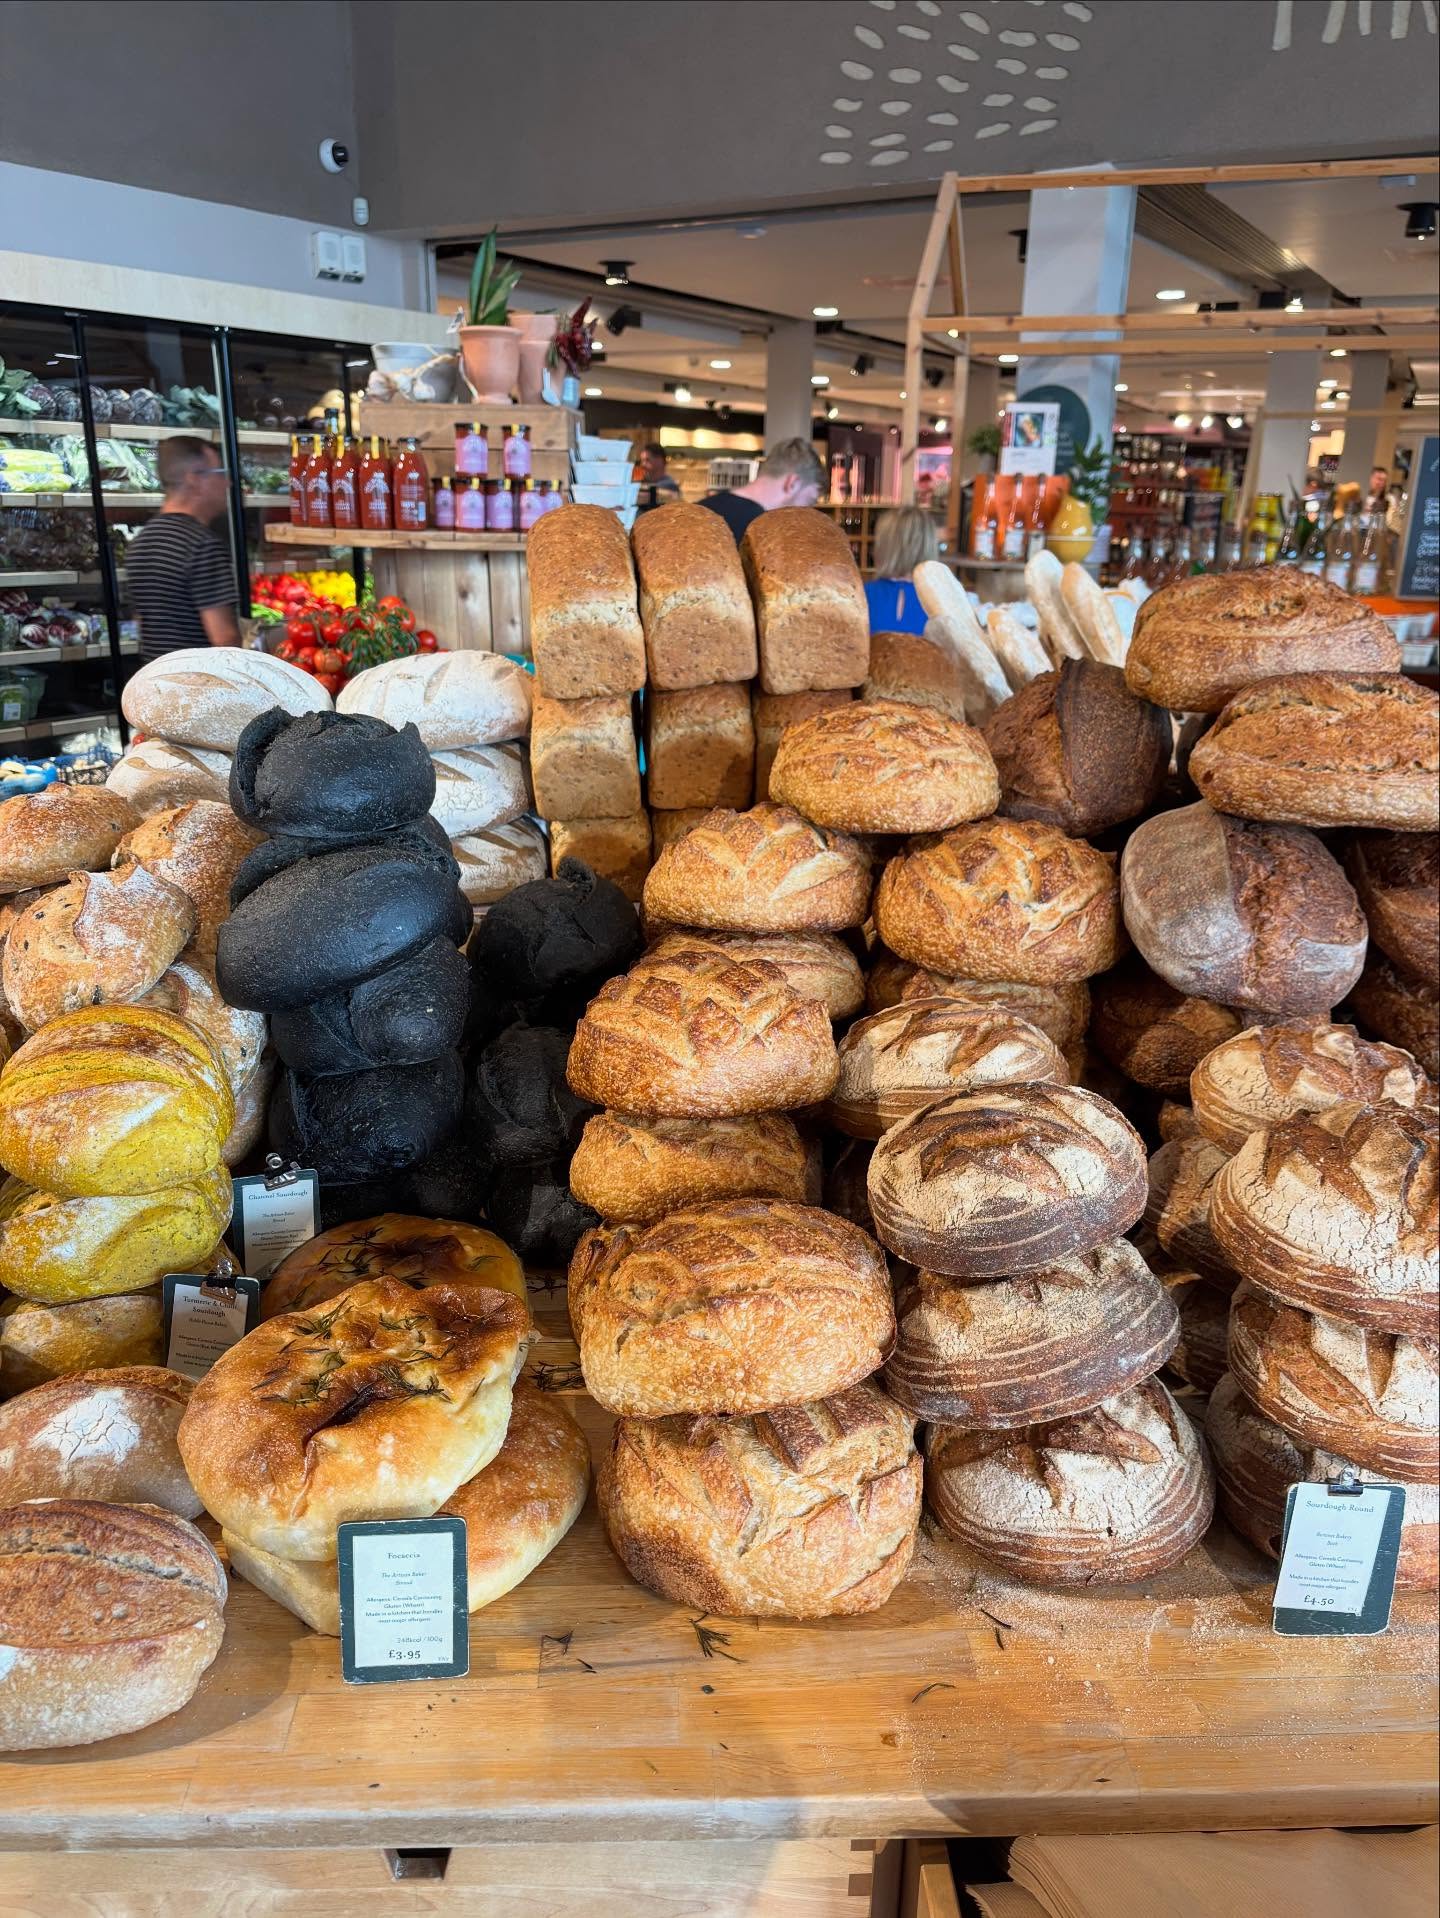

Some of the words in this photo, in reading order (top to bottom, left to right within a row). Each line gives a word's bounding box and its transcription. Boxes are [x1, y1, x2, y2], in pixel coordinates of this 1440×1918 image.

[183, 1295, 211, 1305] Turmeric
[192, 1307, 226, 1317] Sourdough
[1306, 1500, 1347, 1512] Sourdough
[1349, 1504, 1375, 1512] Round
[387, 1552, 421, 1560] Focaccia
[1303, 1594, 1335, 1606] £4.50
[388, 1649, 421, 1660] £3.95
